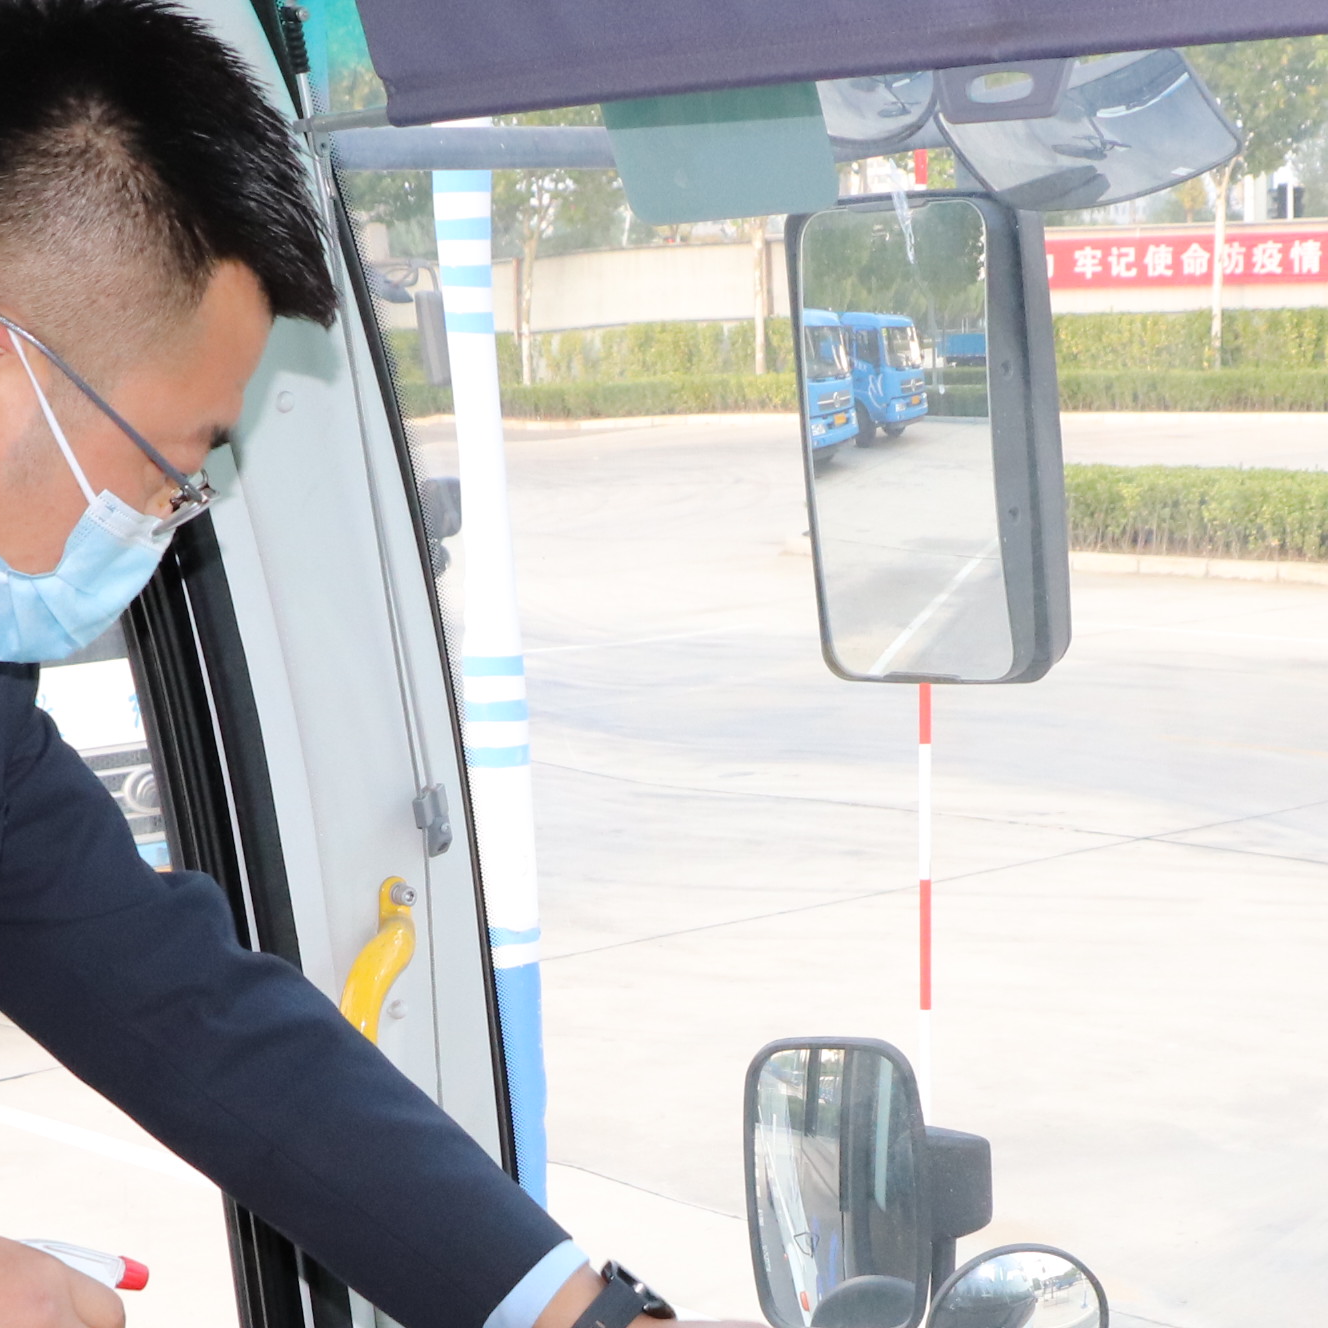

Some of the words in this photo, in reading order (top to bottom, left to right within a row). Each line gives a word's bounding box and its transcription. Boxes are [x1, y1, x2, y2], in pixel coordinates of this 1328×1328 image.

[1074, 240, 1322, 279] 牢记使命防疫情
